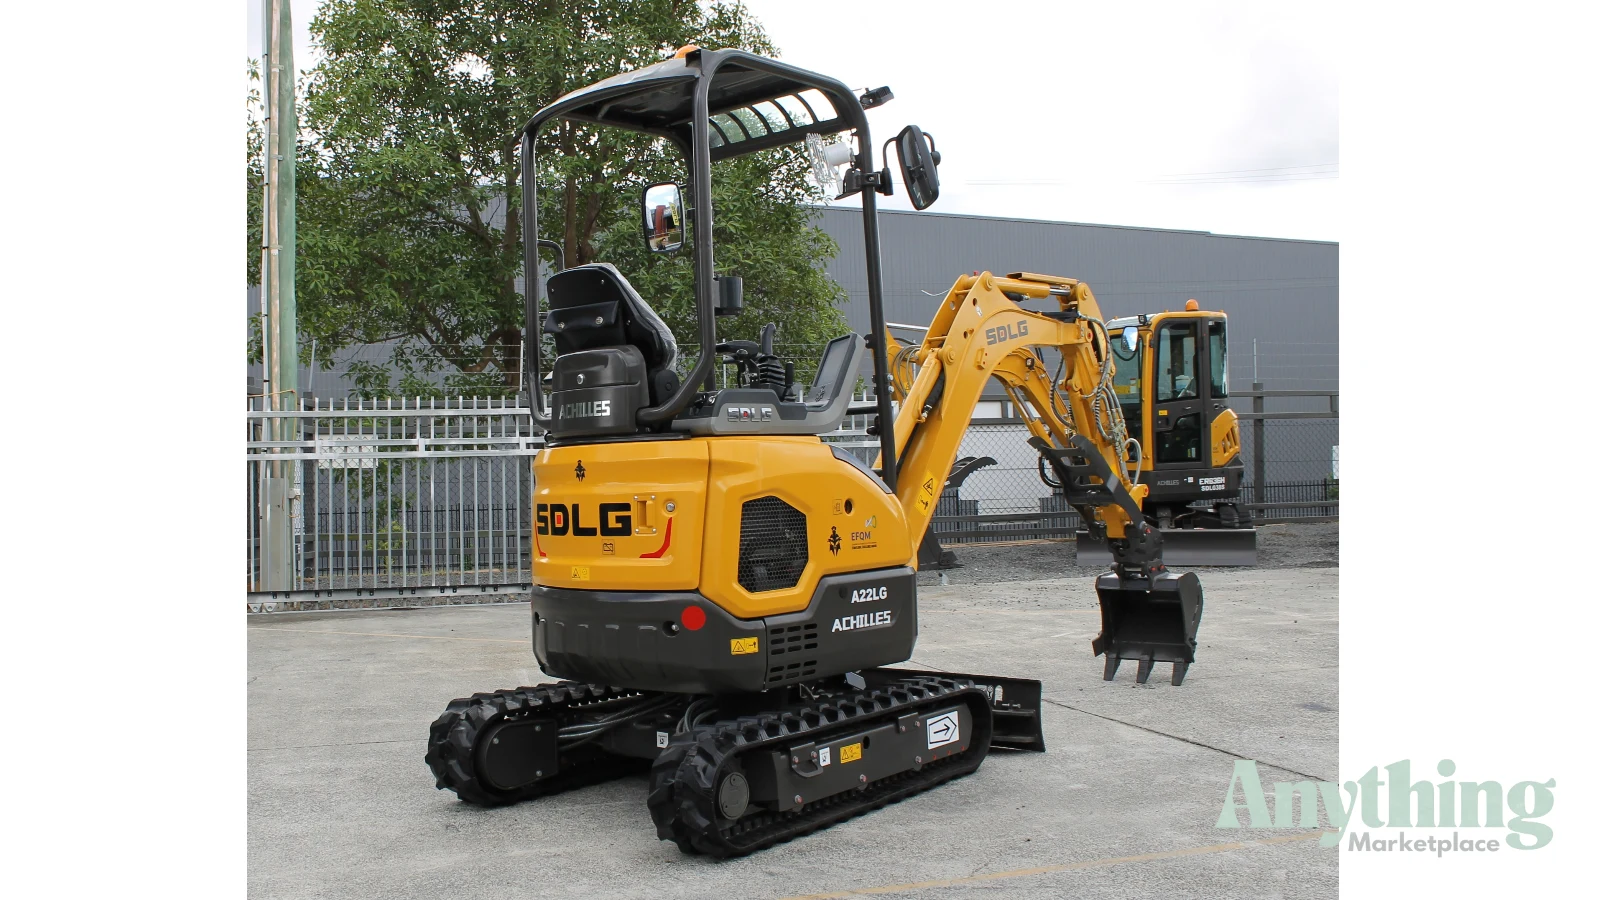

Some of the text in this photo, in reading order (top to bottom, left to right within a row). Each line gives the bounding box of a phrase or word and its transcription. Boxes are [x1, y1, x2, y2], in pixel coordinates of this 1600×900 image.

[985, 319, 1029, 346] SDLG
[558, 400, 611, 420] ACHILLES
[727, 407, 772, 422] SDLG
[536, 502, 632, 537] SDLG
[851, 531, 871, 541] EFQM
[850, 586, 888, 604] A22LG
[831, 610, 892, 633] ACHILLES
